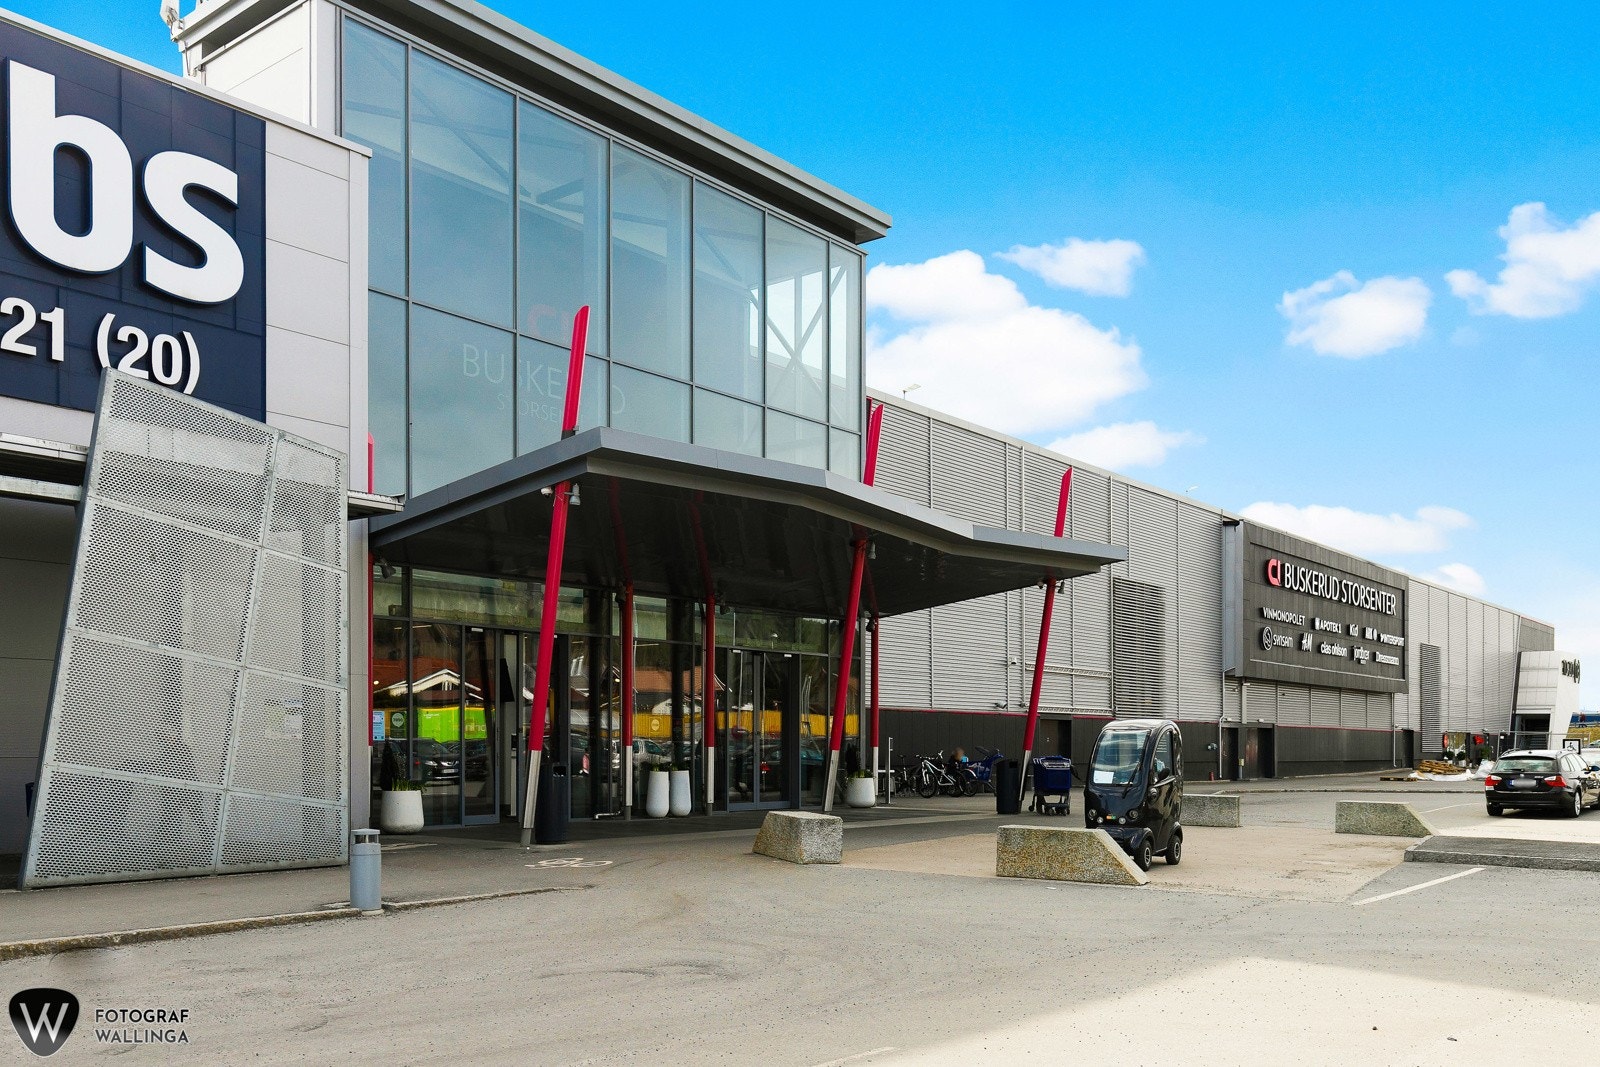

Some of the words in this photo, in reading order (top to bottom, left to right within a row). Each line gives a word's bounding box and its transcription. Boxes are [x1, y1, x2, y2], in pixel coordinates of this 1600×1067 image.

[97, 312, 200, 395] (20)
[463, 343, 626, 415] BUKED
[1284, 563, 1339, 600] BUSKERUD
[1341, 579, 1396, 615] STORSENTER
[1262, 606, 1305, 626] VINMONOPOLET
[1320, 619, 1338, 633] APOTEK
